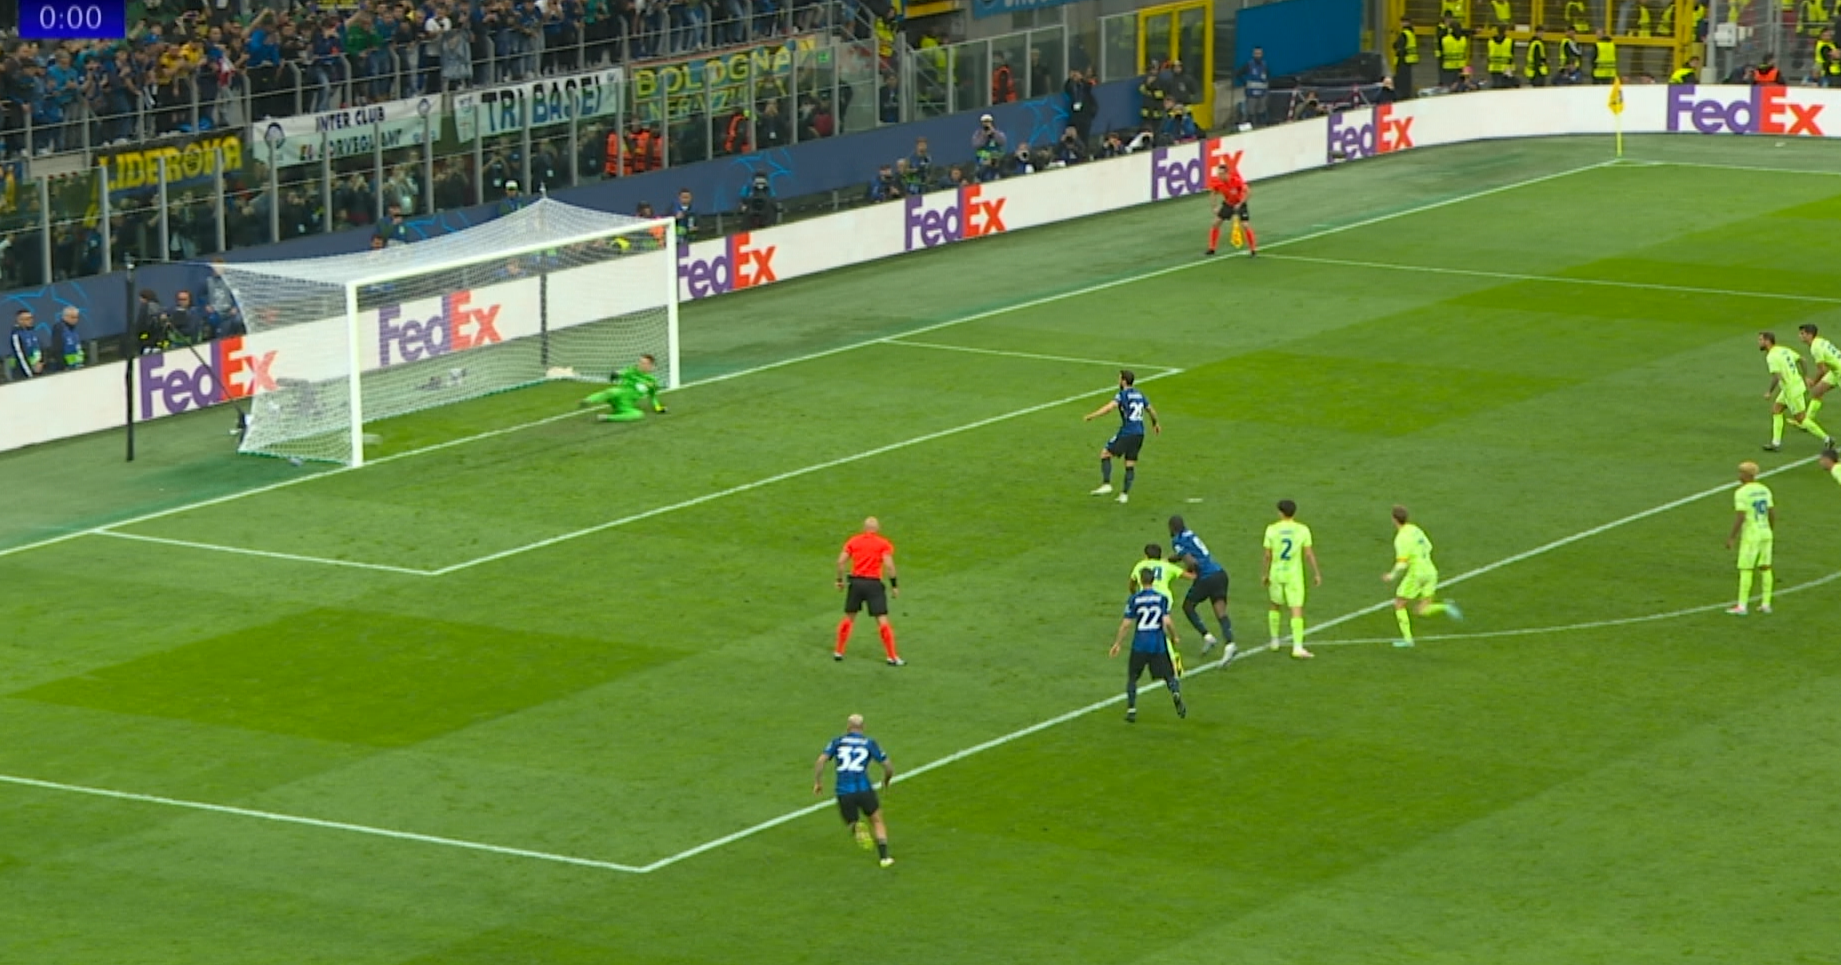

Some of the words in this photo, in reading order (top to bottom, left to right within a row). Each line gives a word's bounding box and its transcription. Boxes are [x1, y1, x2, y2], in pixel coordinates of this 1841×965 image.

[635, 45, 793, 96] BOLOGNA
[316, 112, 351, 133] INTER
[355, 106, 385, 126] CLUB
[481, 88, 525, 132] TRI
[1327, 101, 1414, 165] FedEx
[1667, 84, 1825, 136] FedEx
[1151, 136, 1244, 201] FedEx
[905, 182, 1006, 252] FedEx
[379, 290, 503, 368] FedEx
[140, 336, 278, 419] FedEx
[1280, 538, 1294, 561] 2
[1136, 605, 1162, 631] 22
[836, 745, 869, 772] 32
